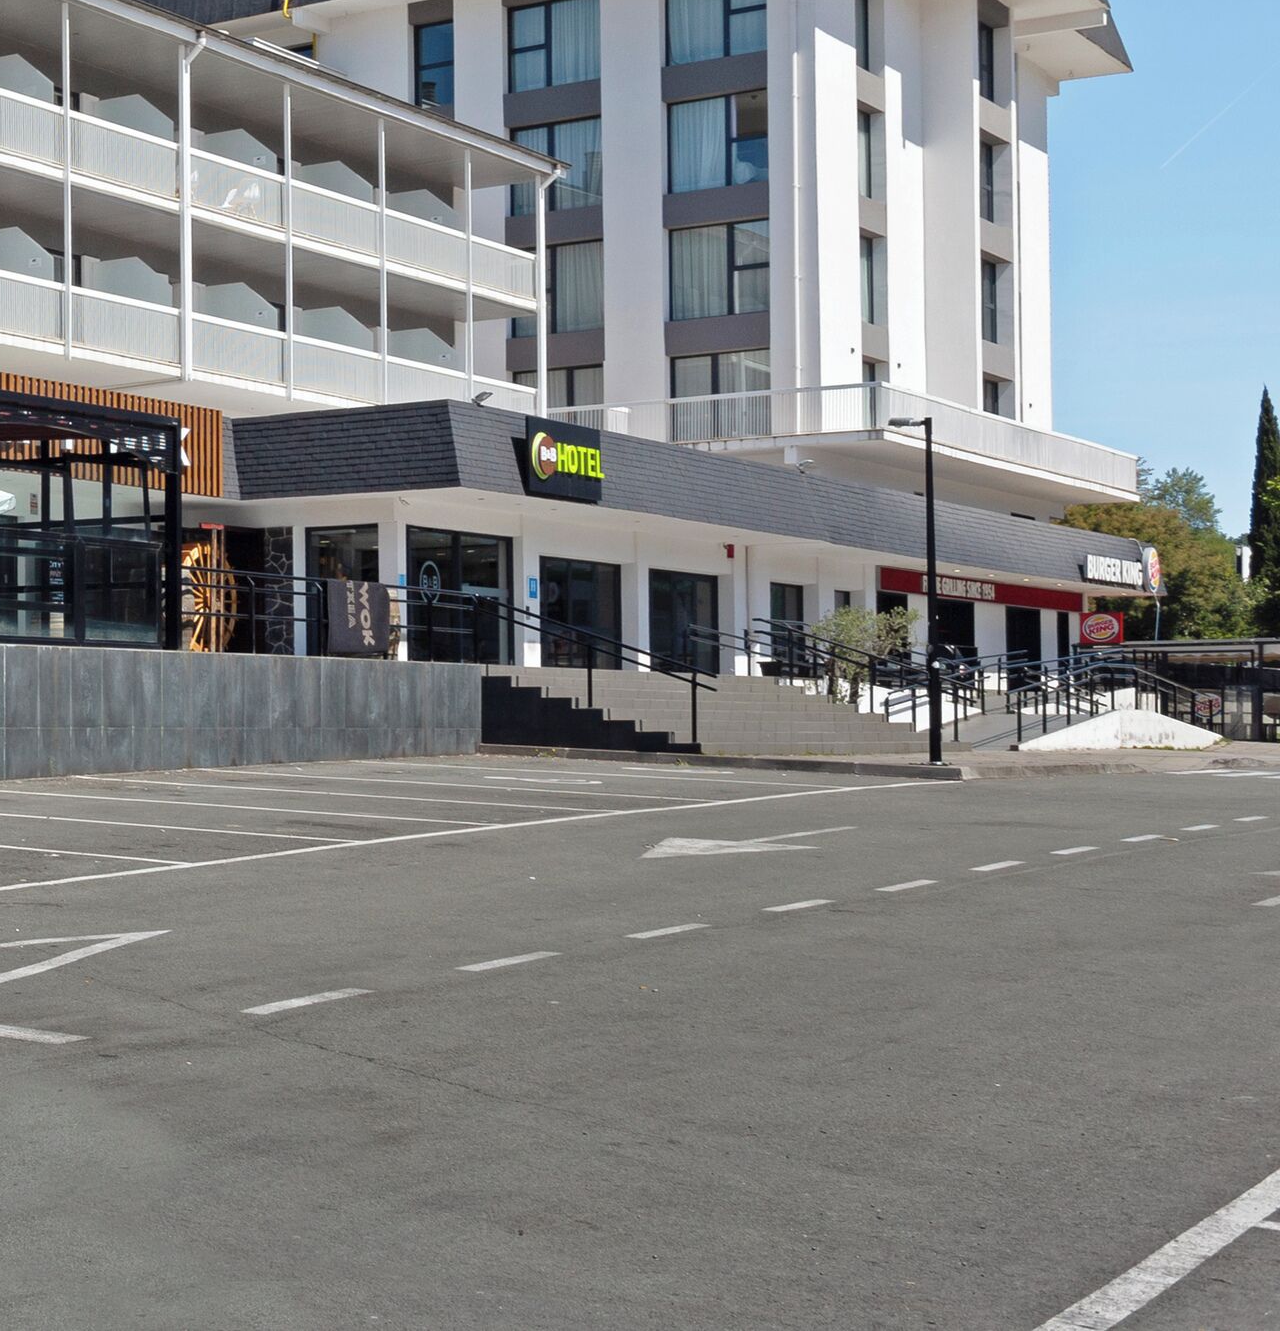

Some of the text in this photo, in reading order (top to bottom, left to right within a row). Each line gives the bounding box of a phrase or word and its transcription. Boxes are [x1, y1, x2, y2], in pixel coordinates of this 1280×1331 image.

[556, 442, 606, 479] HOTEL
[1087, 554, 1121, 583] BURGER
[1122, 559, 1143, 586] KING
[358, 581, 376, 646] WOK
[1088, 623, 1114, 634] KING
